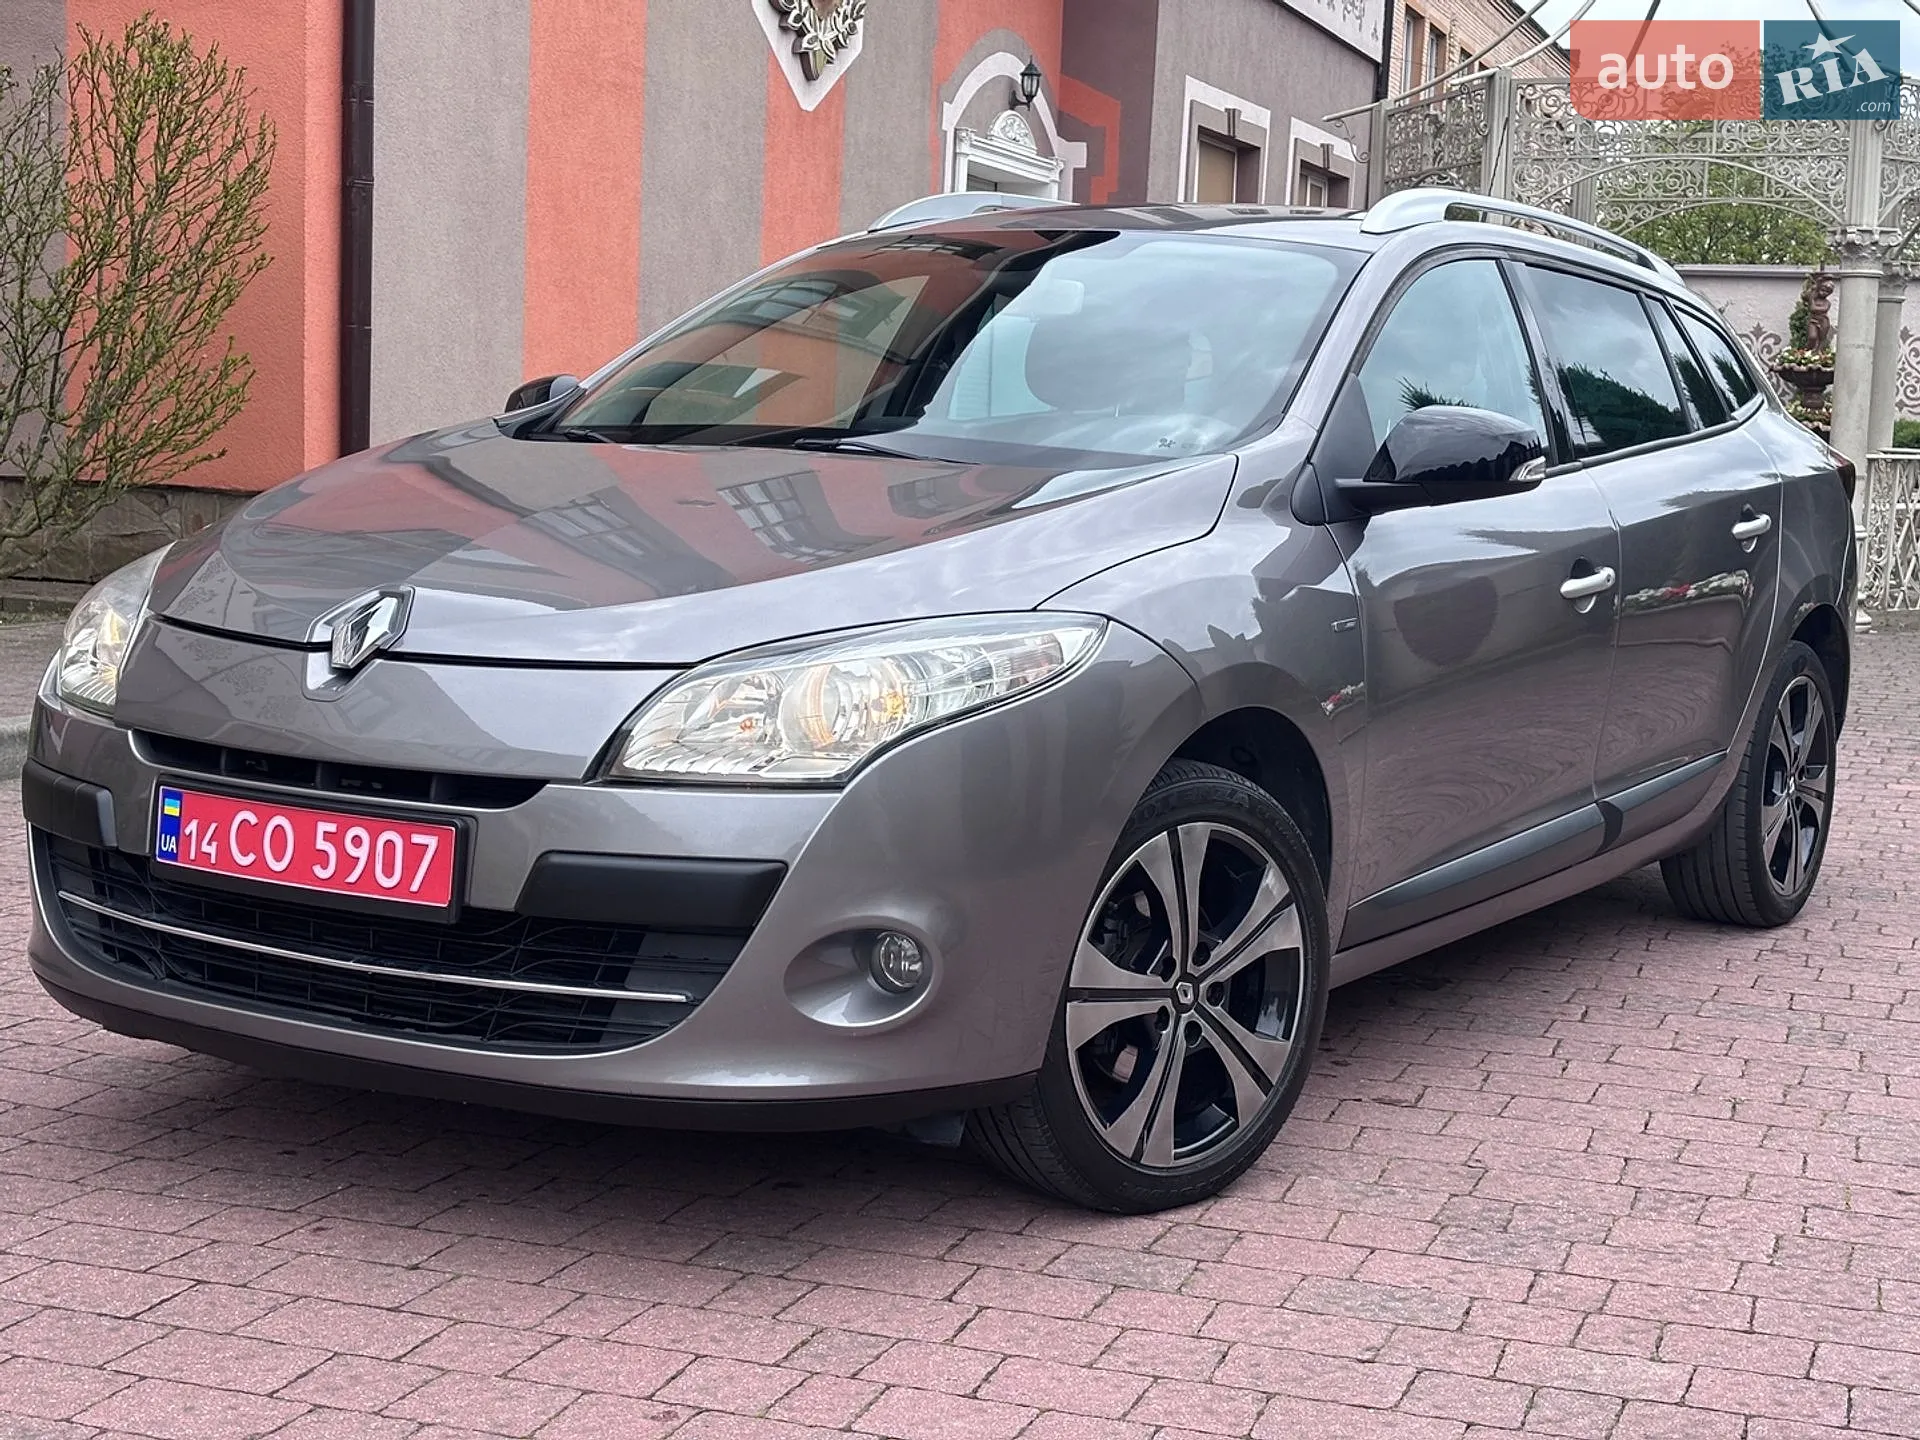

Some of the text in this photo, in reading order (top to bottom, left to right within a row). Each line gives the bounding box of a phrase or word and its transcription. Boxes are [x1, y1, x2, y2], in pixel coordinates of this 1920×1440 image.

[161, 835, 177, 854] UA
[184, 810, 439, 893] 14 CO 5907
